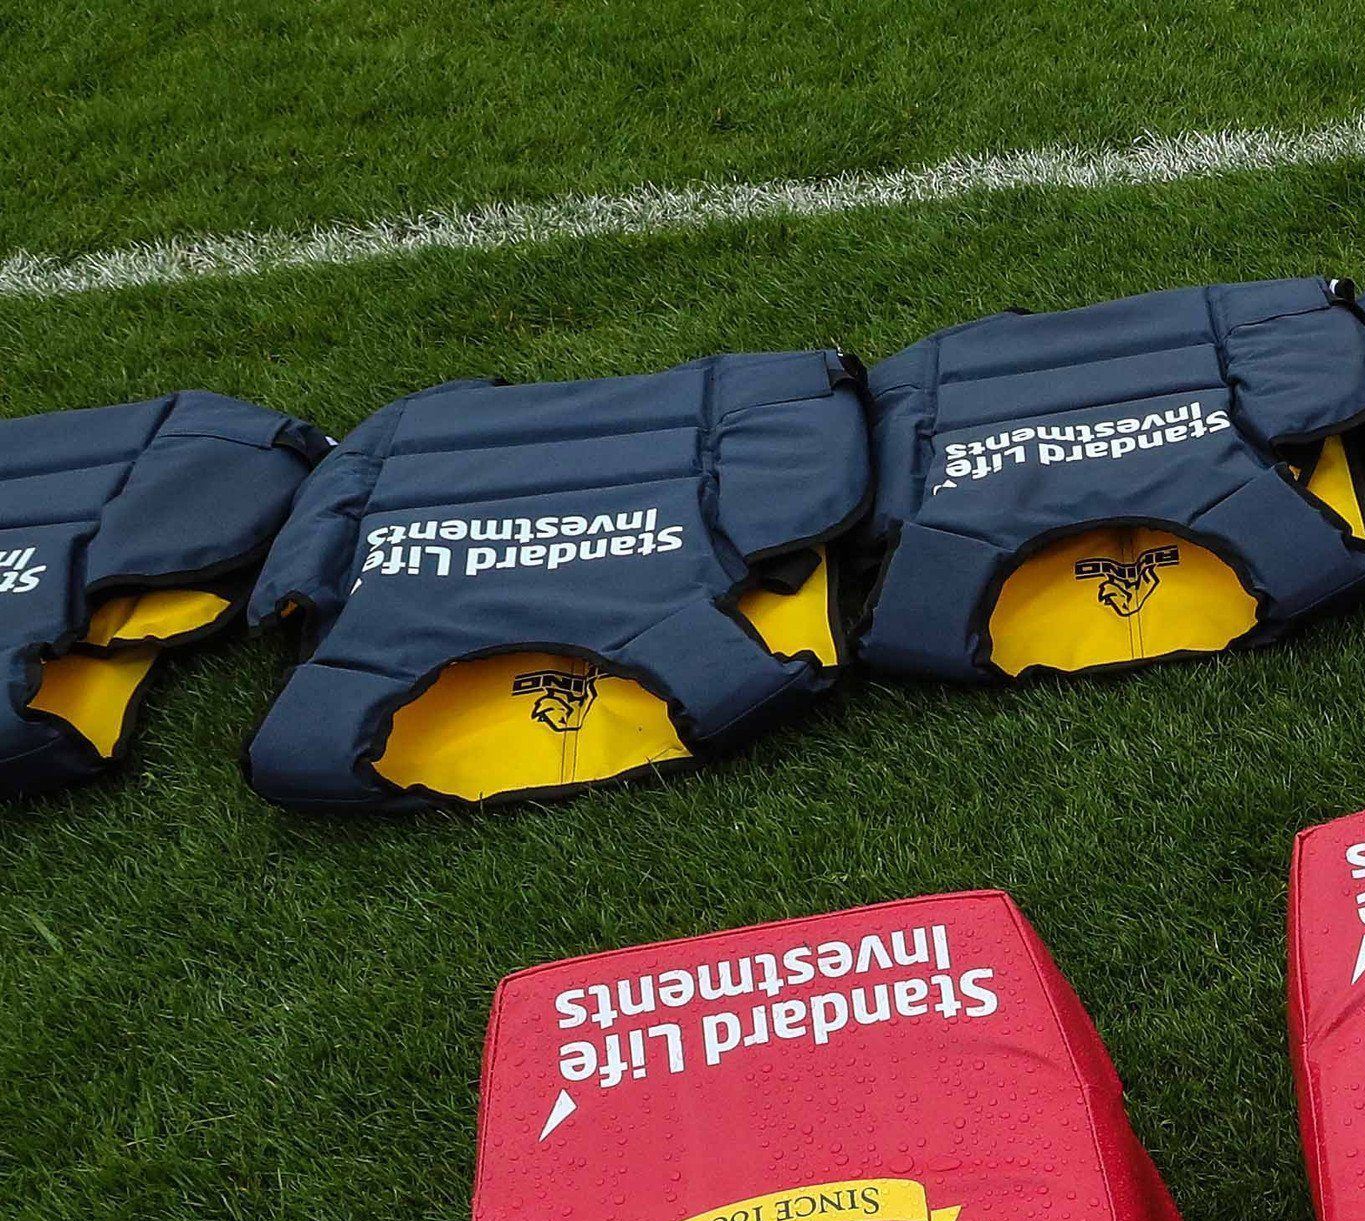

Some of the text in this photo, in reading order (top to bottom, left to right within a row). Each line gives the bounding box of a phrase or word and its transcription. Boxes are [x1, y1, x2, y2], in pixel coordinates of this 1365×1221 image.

[945, 402, 1201, 461] Investments
[945, 410, 1231, 480] Standard Life
[362, 525, 684, 576] Standard Life
[366, 508, 658, 551] Investments
[554, 924, 952, 1030] Investments
[558, 968, 999, 1089] Standard Life
[776, 1186, 881, 1221] SINCE
